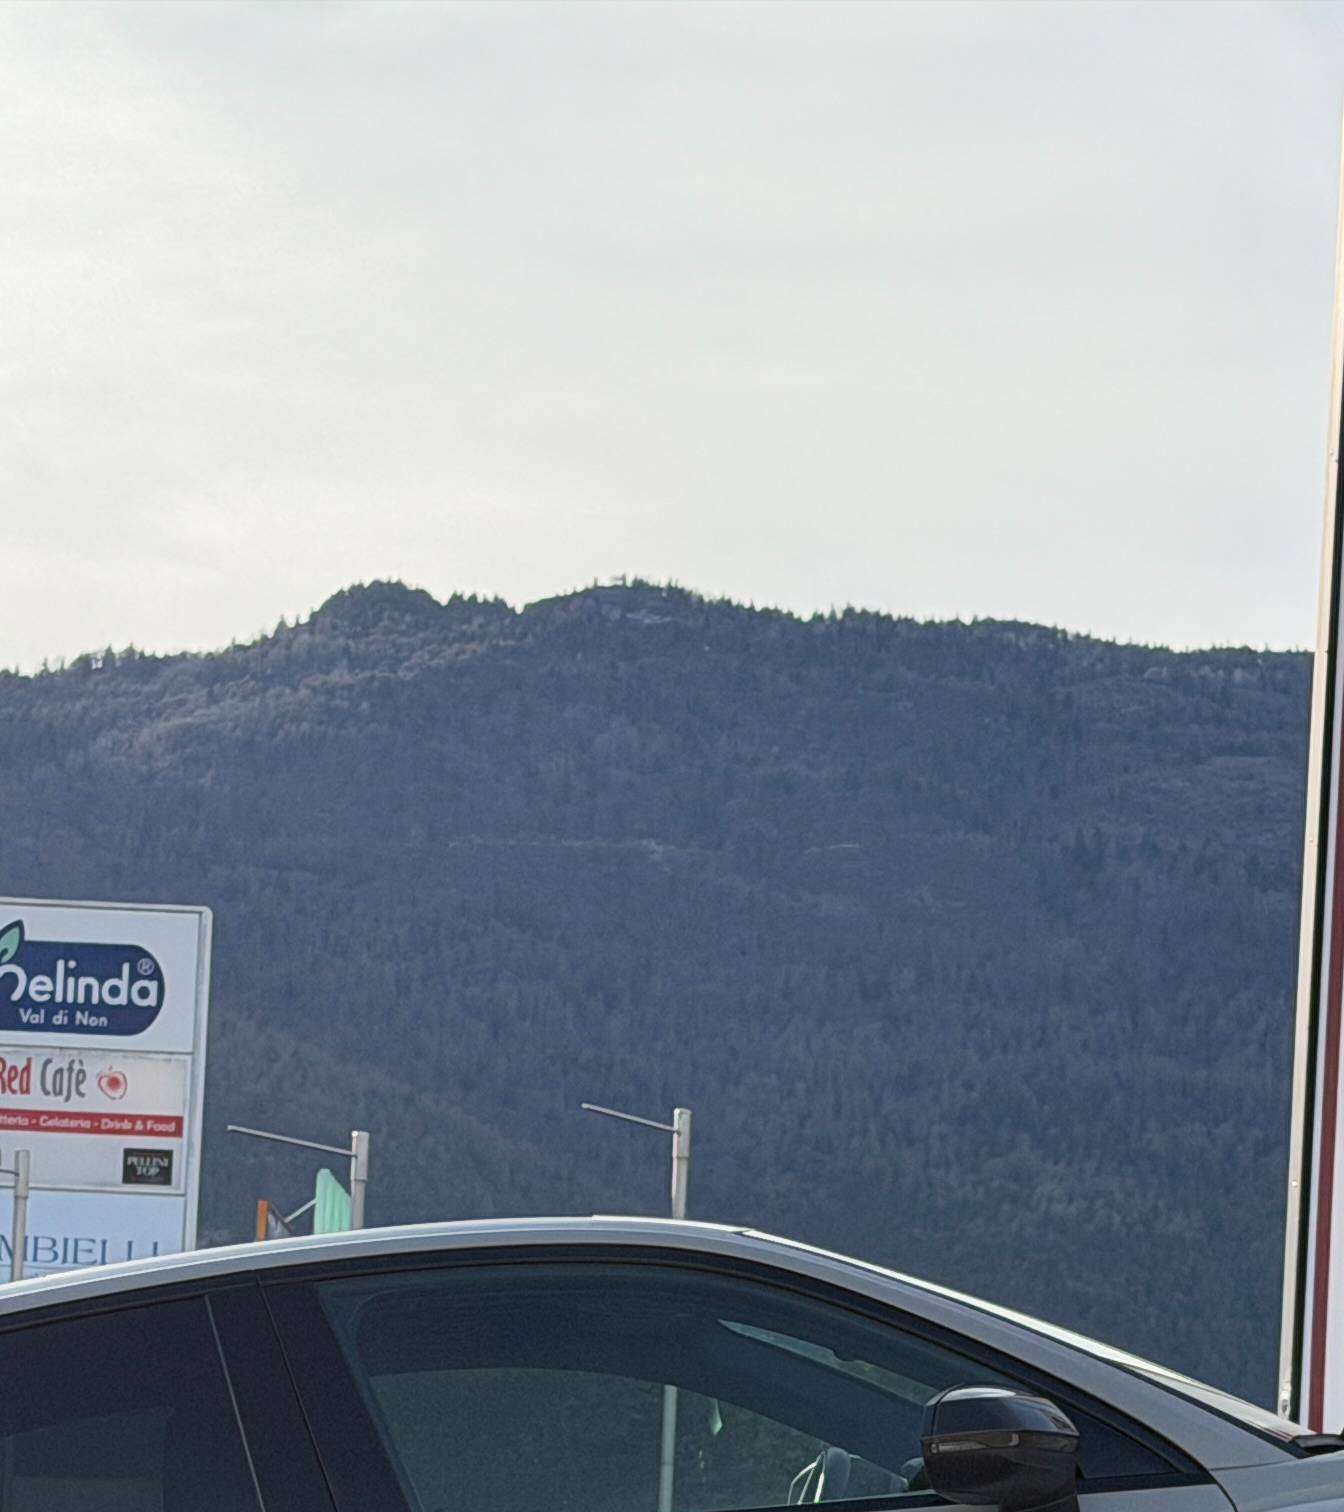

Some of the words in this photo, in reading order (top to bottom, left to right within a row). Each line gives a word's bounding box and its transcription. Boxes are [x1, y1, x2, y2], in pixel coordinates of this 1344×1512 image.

[19, 1007, 45, 1025] Val
[52, 1009, 69, 1026] di
[74, 1010, 109, 1028] Non
[39, 1057, 87, 1103] Cafè
[146, 1120, 176, 1133] Food
